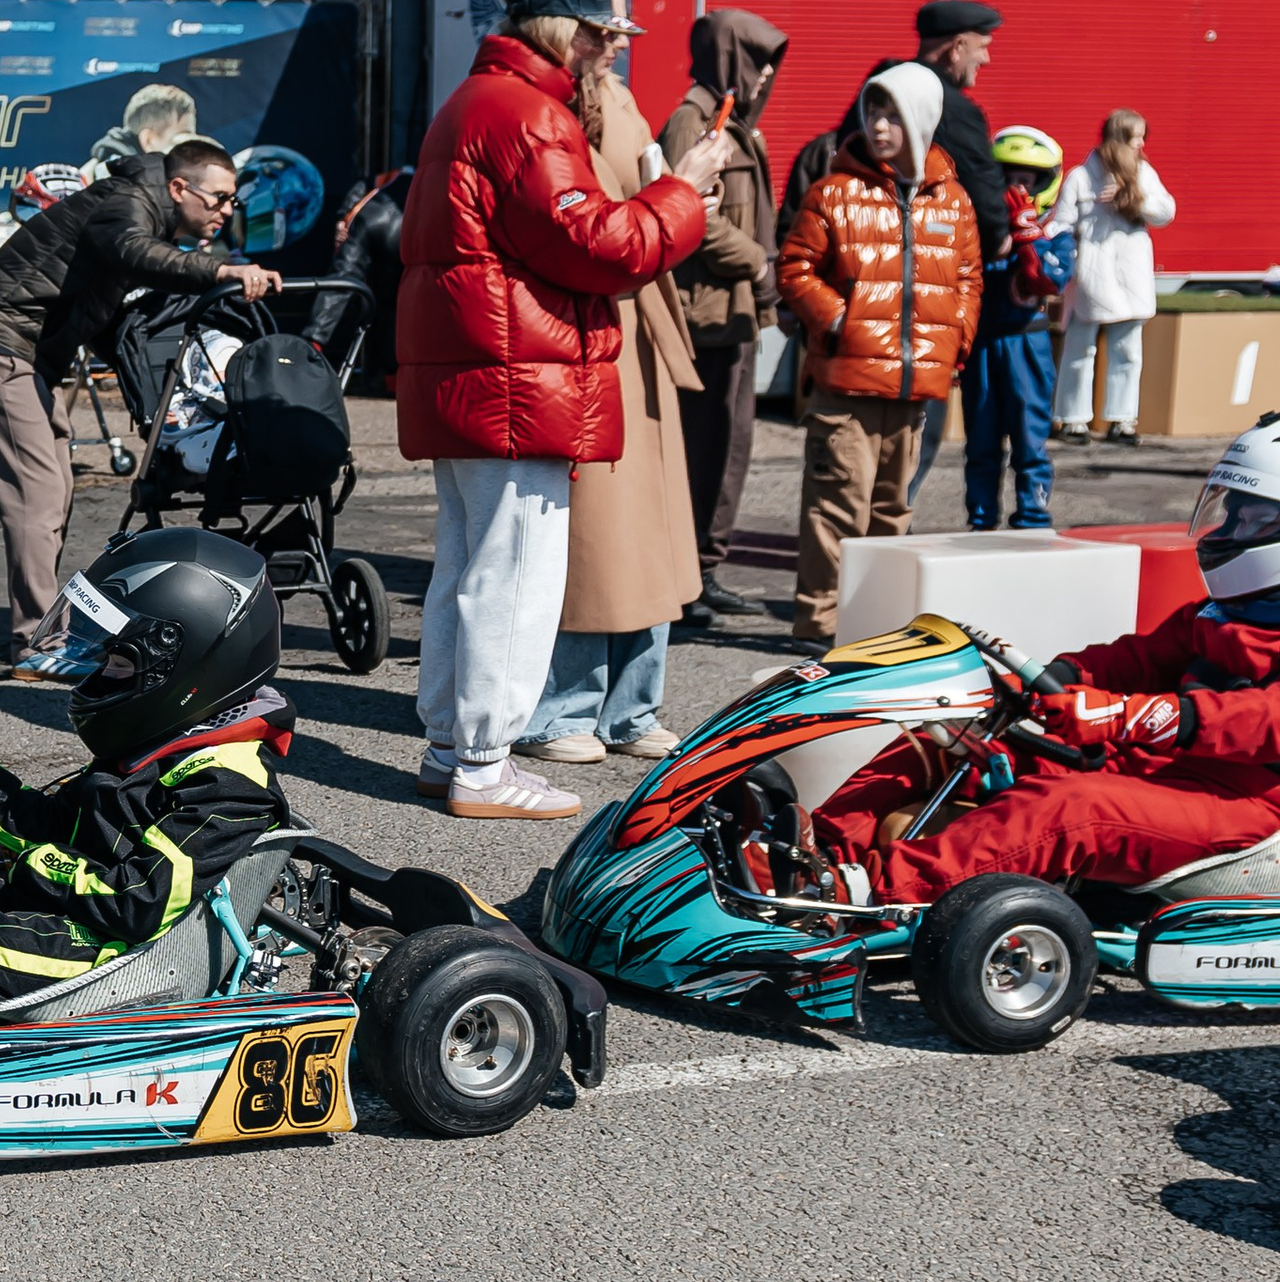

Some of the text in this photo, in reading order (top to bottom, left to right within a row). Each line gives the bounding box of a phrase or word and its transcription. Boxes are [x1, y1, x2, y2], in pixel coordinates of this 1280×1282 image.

[74, 587, 101, 614] RACING
[146, 1081, 179, 1106] K
[233, 1027, 350, 1134] 86
